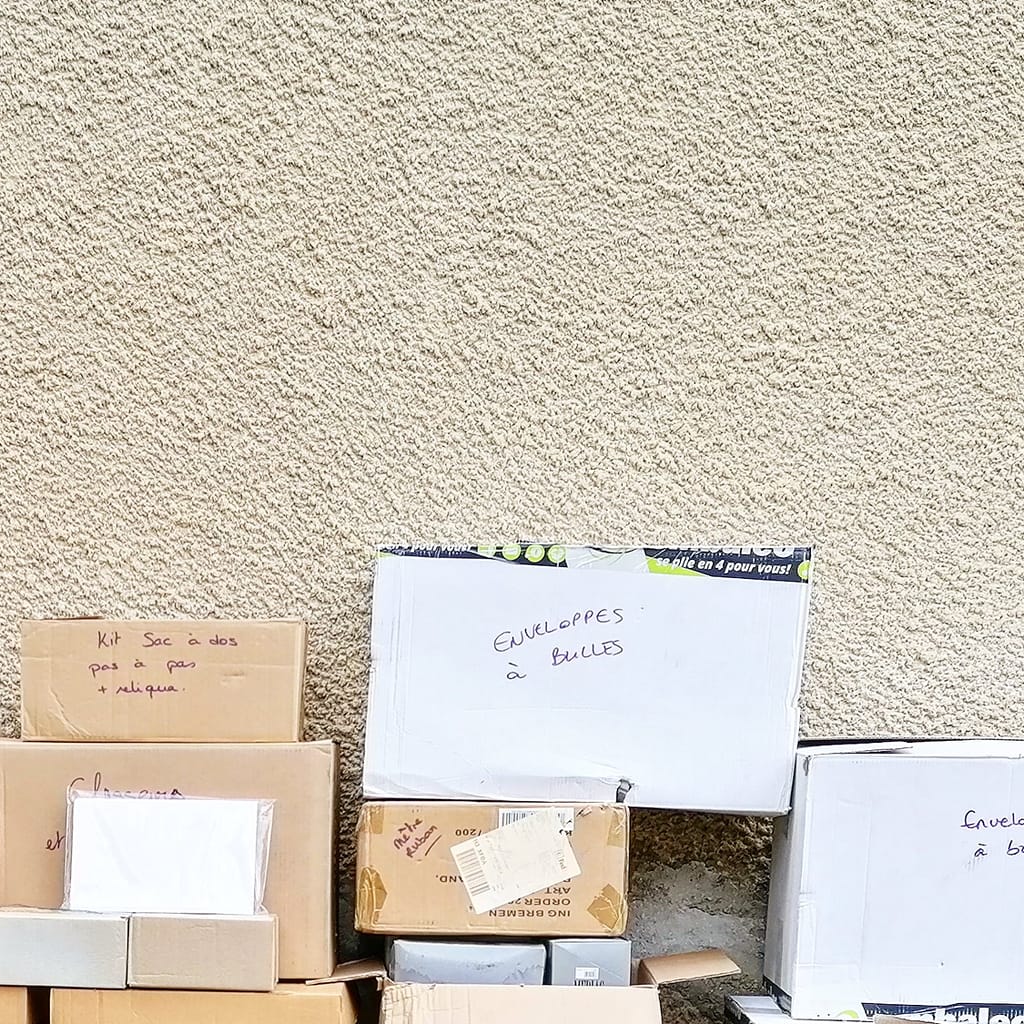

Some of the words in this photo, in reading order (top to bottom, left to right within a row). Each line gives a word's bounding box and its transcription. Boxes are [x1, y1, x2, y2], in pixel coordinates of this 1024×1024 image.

[672, 556, 695, 570] plie
[697, 560, 713, 570] en
[715, 559, 724, 570] 4
[724, 561, 756, 573] pour
[757, 563, 792, 575] vous!
[493, 606, 624, 653] ENVELOPPES
[97, 631, 121, 648] Kit
[143, 632, 172, 648] Sac
[188, 633, 201, 646] à
[209, 634, 238, 647] dos
[506, 661, 527, 680] à
[552, 639, 624, 667] BULLES
[88, 662, 118, 678] pas
[134, 658, 147, 668] à
[97, 685, 106, 694] +
[974, 843, 988, 858] à
[544, 886, 571, 896] ART
[524, 897, 571, 906] ORDER
[489, 909, 546, 917] BREMEN
[551, 909, 571, 917] ING
